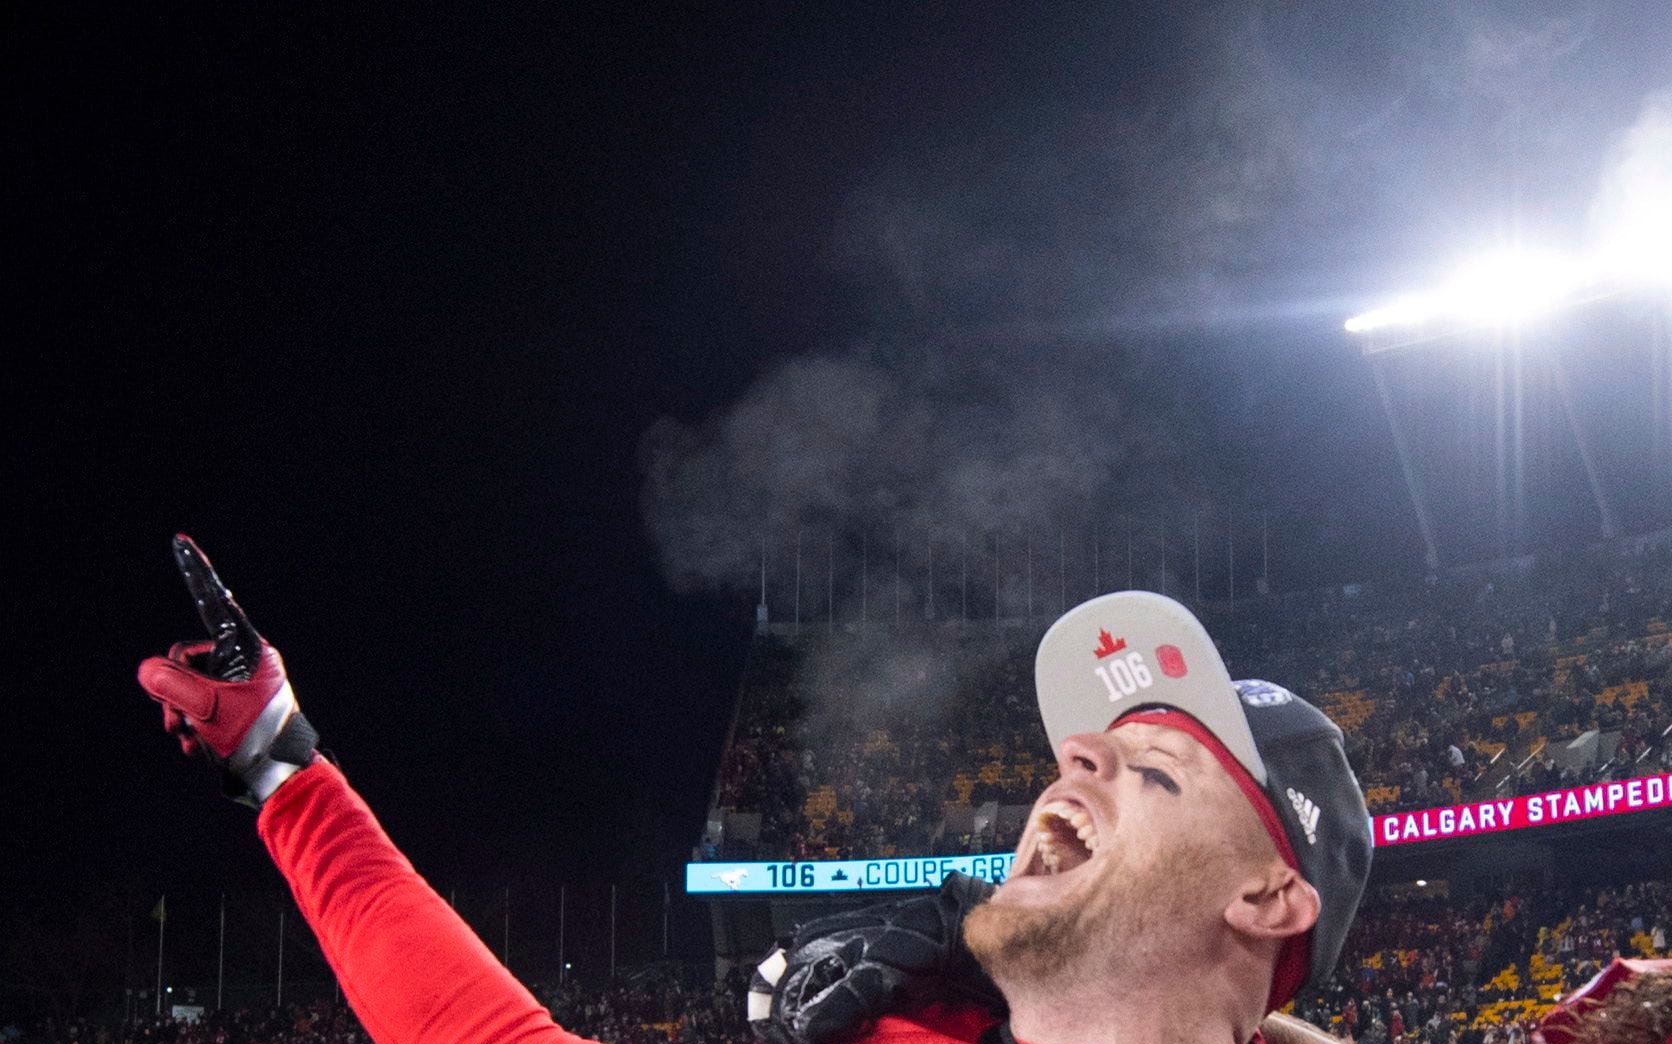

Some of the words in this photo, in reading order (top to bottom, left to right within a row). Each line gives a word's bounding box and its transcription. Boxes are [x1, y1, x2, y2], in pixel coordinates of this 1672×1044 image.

[1095, 651, 1153, 702] 106
[1383, 800, 1513, 842] CALGARY
[767, 864, 815, 888] 106
[866, 858, 952, 885] COUPE
[972, 857, 1016, 881] GR
